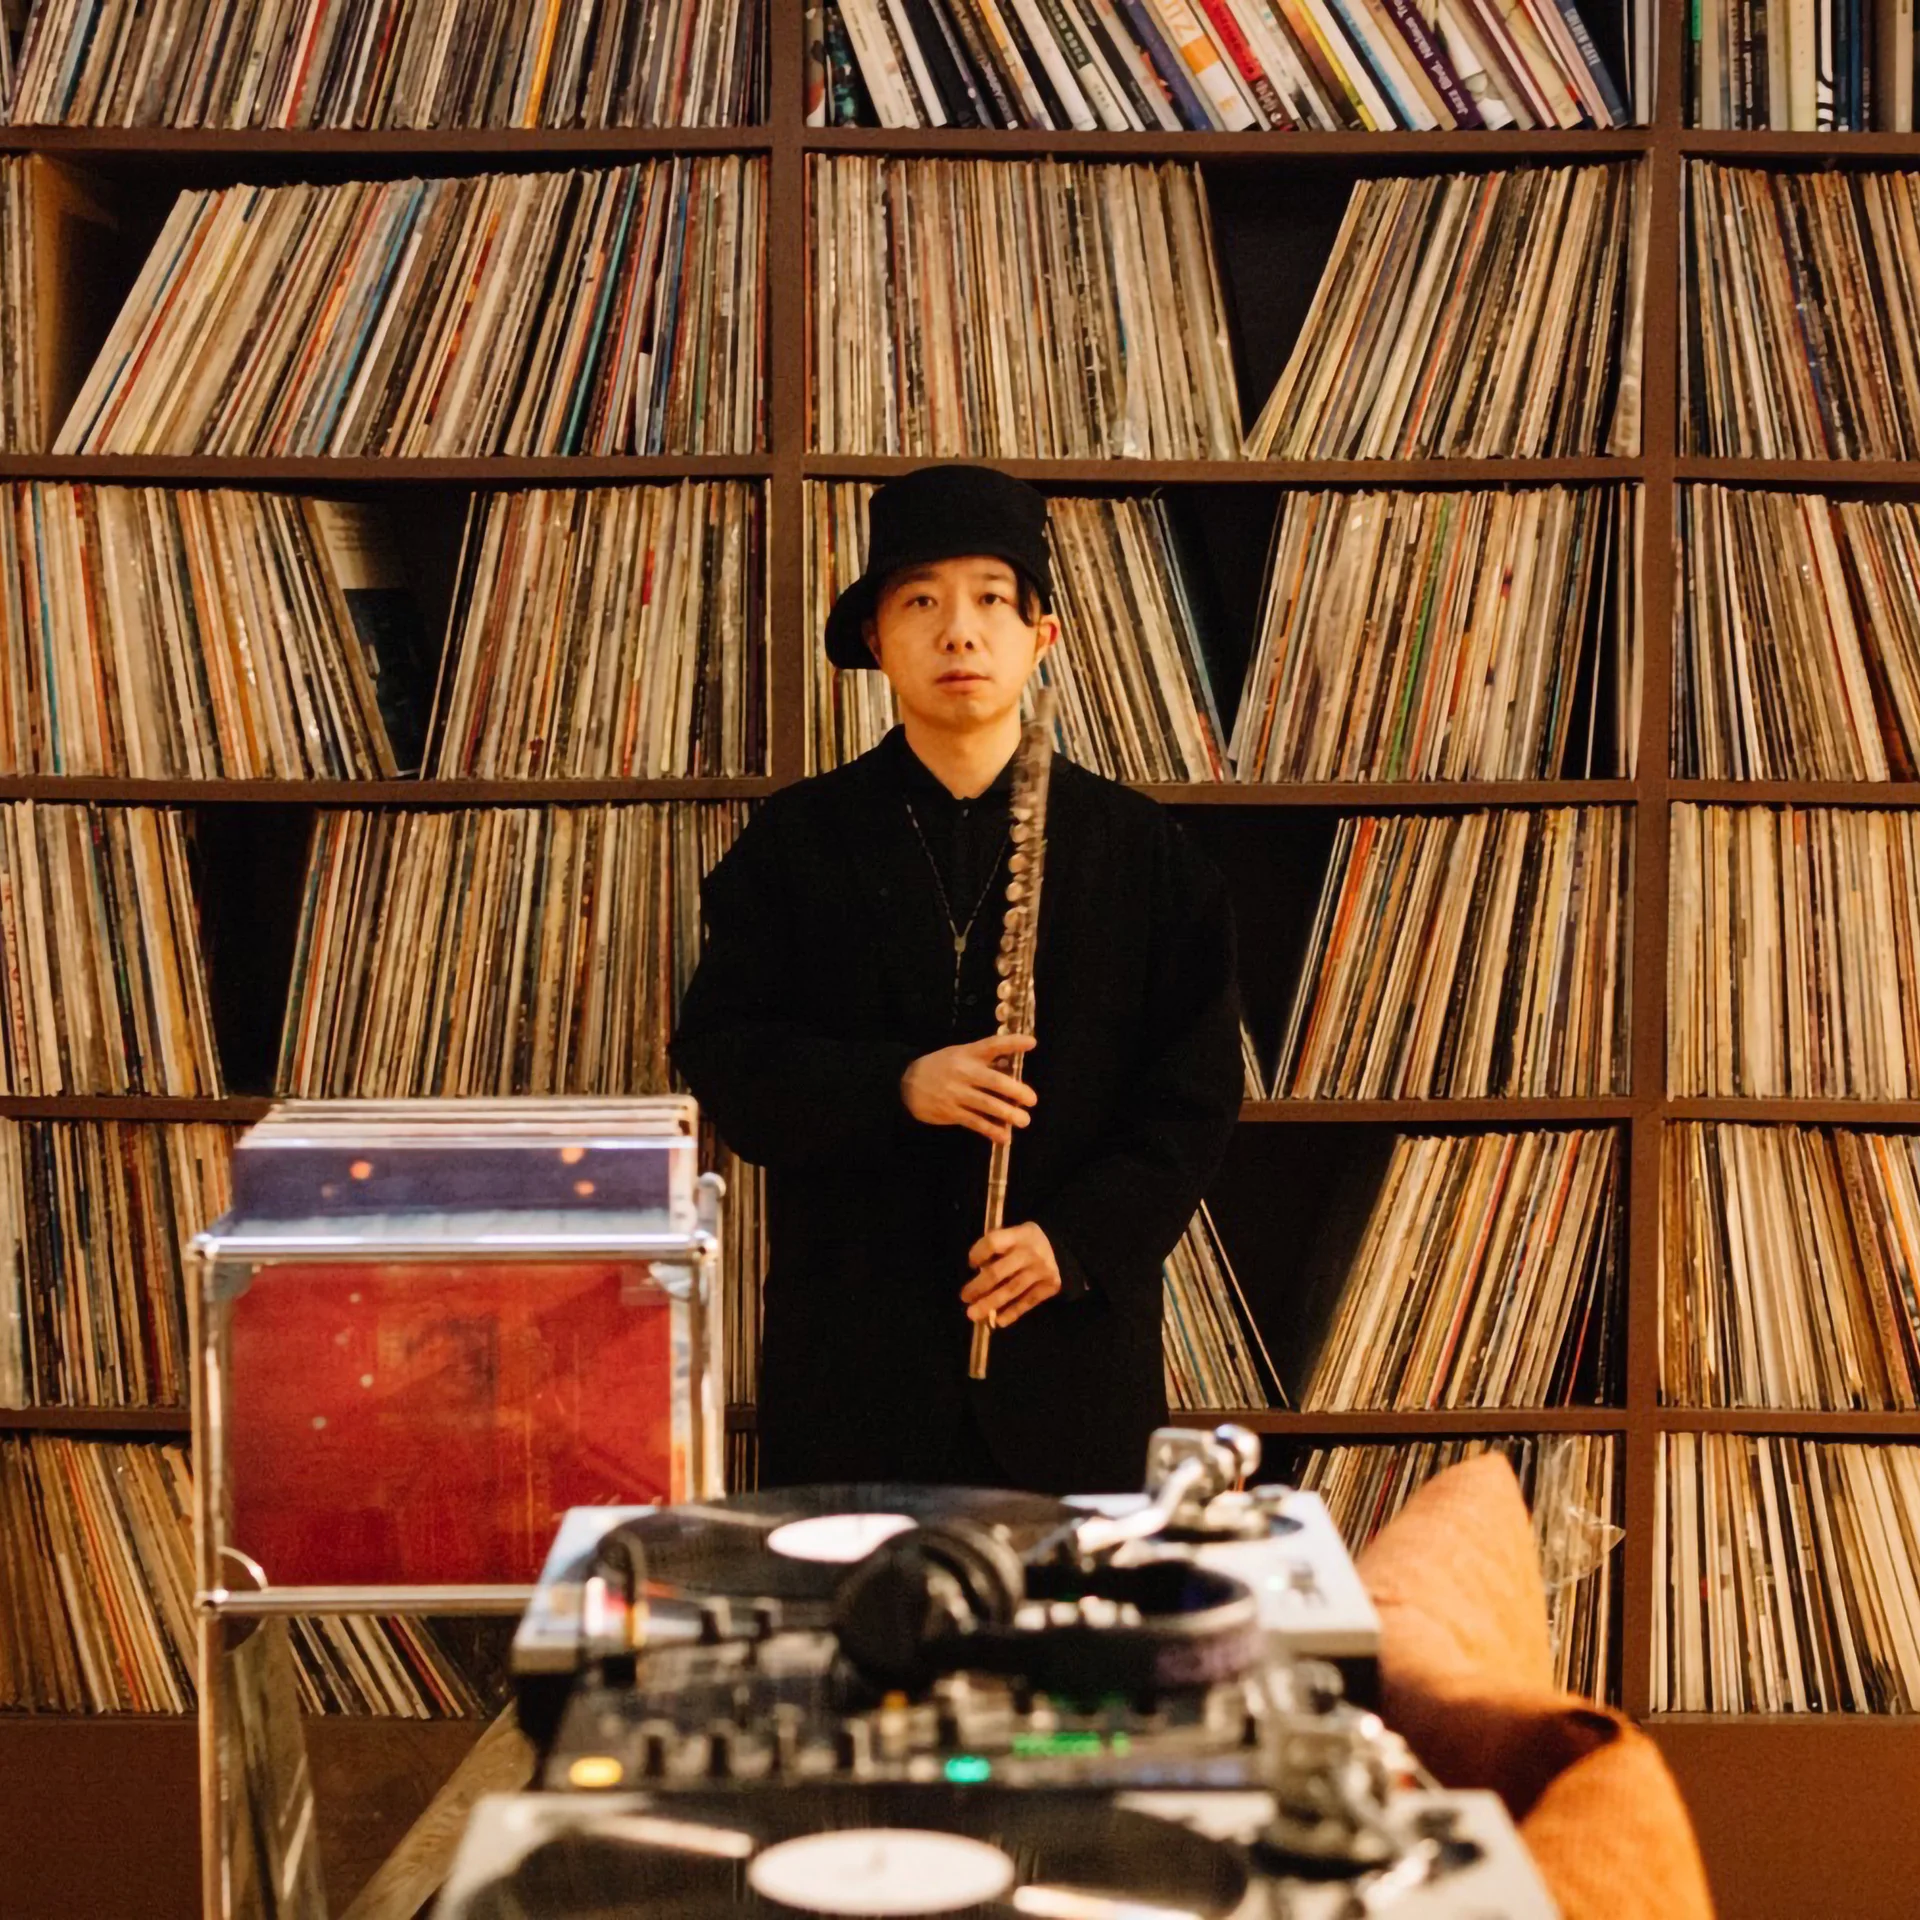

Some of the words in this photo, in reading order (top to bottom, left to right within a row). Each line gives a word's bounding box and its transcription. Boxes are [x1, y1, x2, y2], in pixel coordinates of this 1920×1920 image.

[1405, 17, 1434, 59] Niklaus
[1431, 60, 1453, 90] Blvd.
[1448, 89, 1469, 114] Jazz
